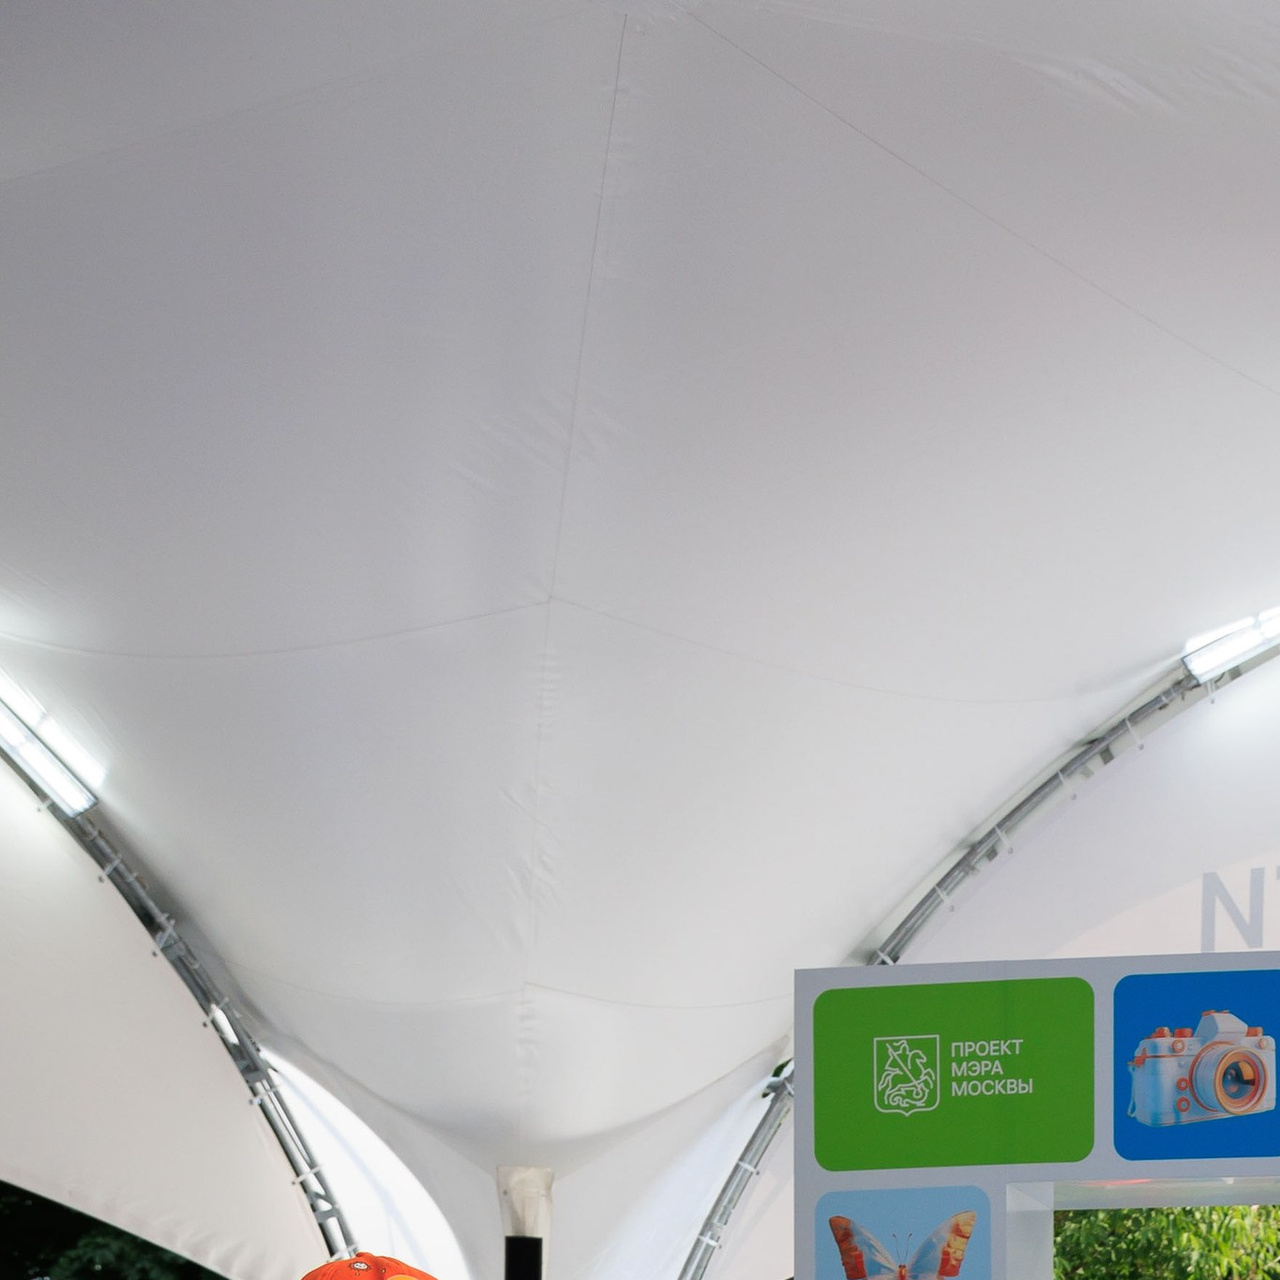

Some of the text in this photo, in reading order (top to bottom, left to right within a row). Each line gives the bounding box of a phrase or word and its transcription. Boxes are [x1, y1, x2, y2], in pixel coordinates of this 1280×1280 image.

[951, 1039, 1023, 1057] ПРОЕКТ
[951, 1060, 1003, 1077] МЭРА
[951, 1079, 1033, 1096] МОСКВЫ
